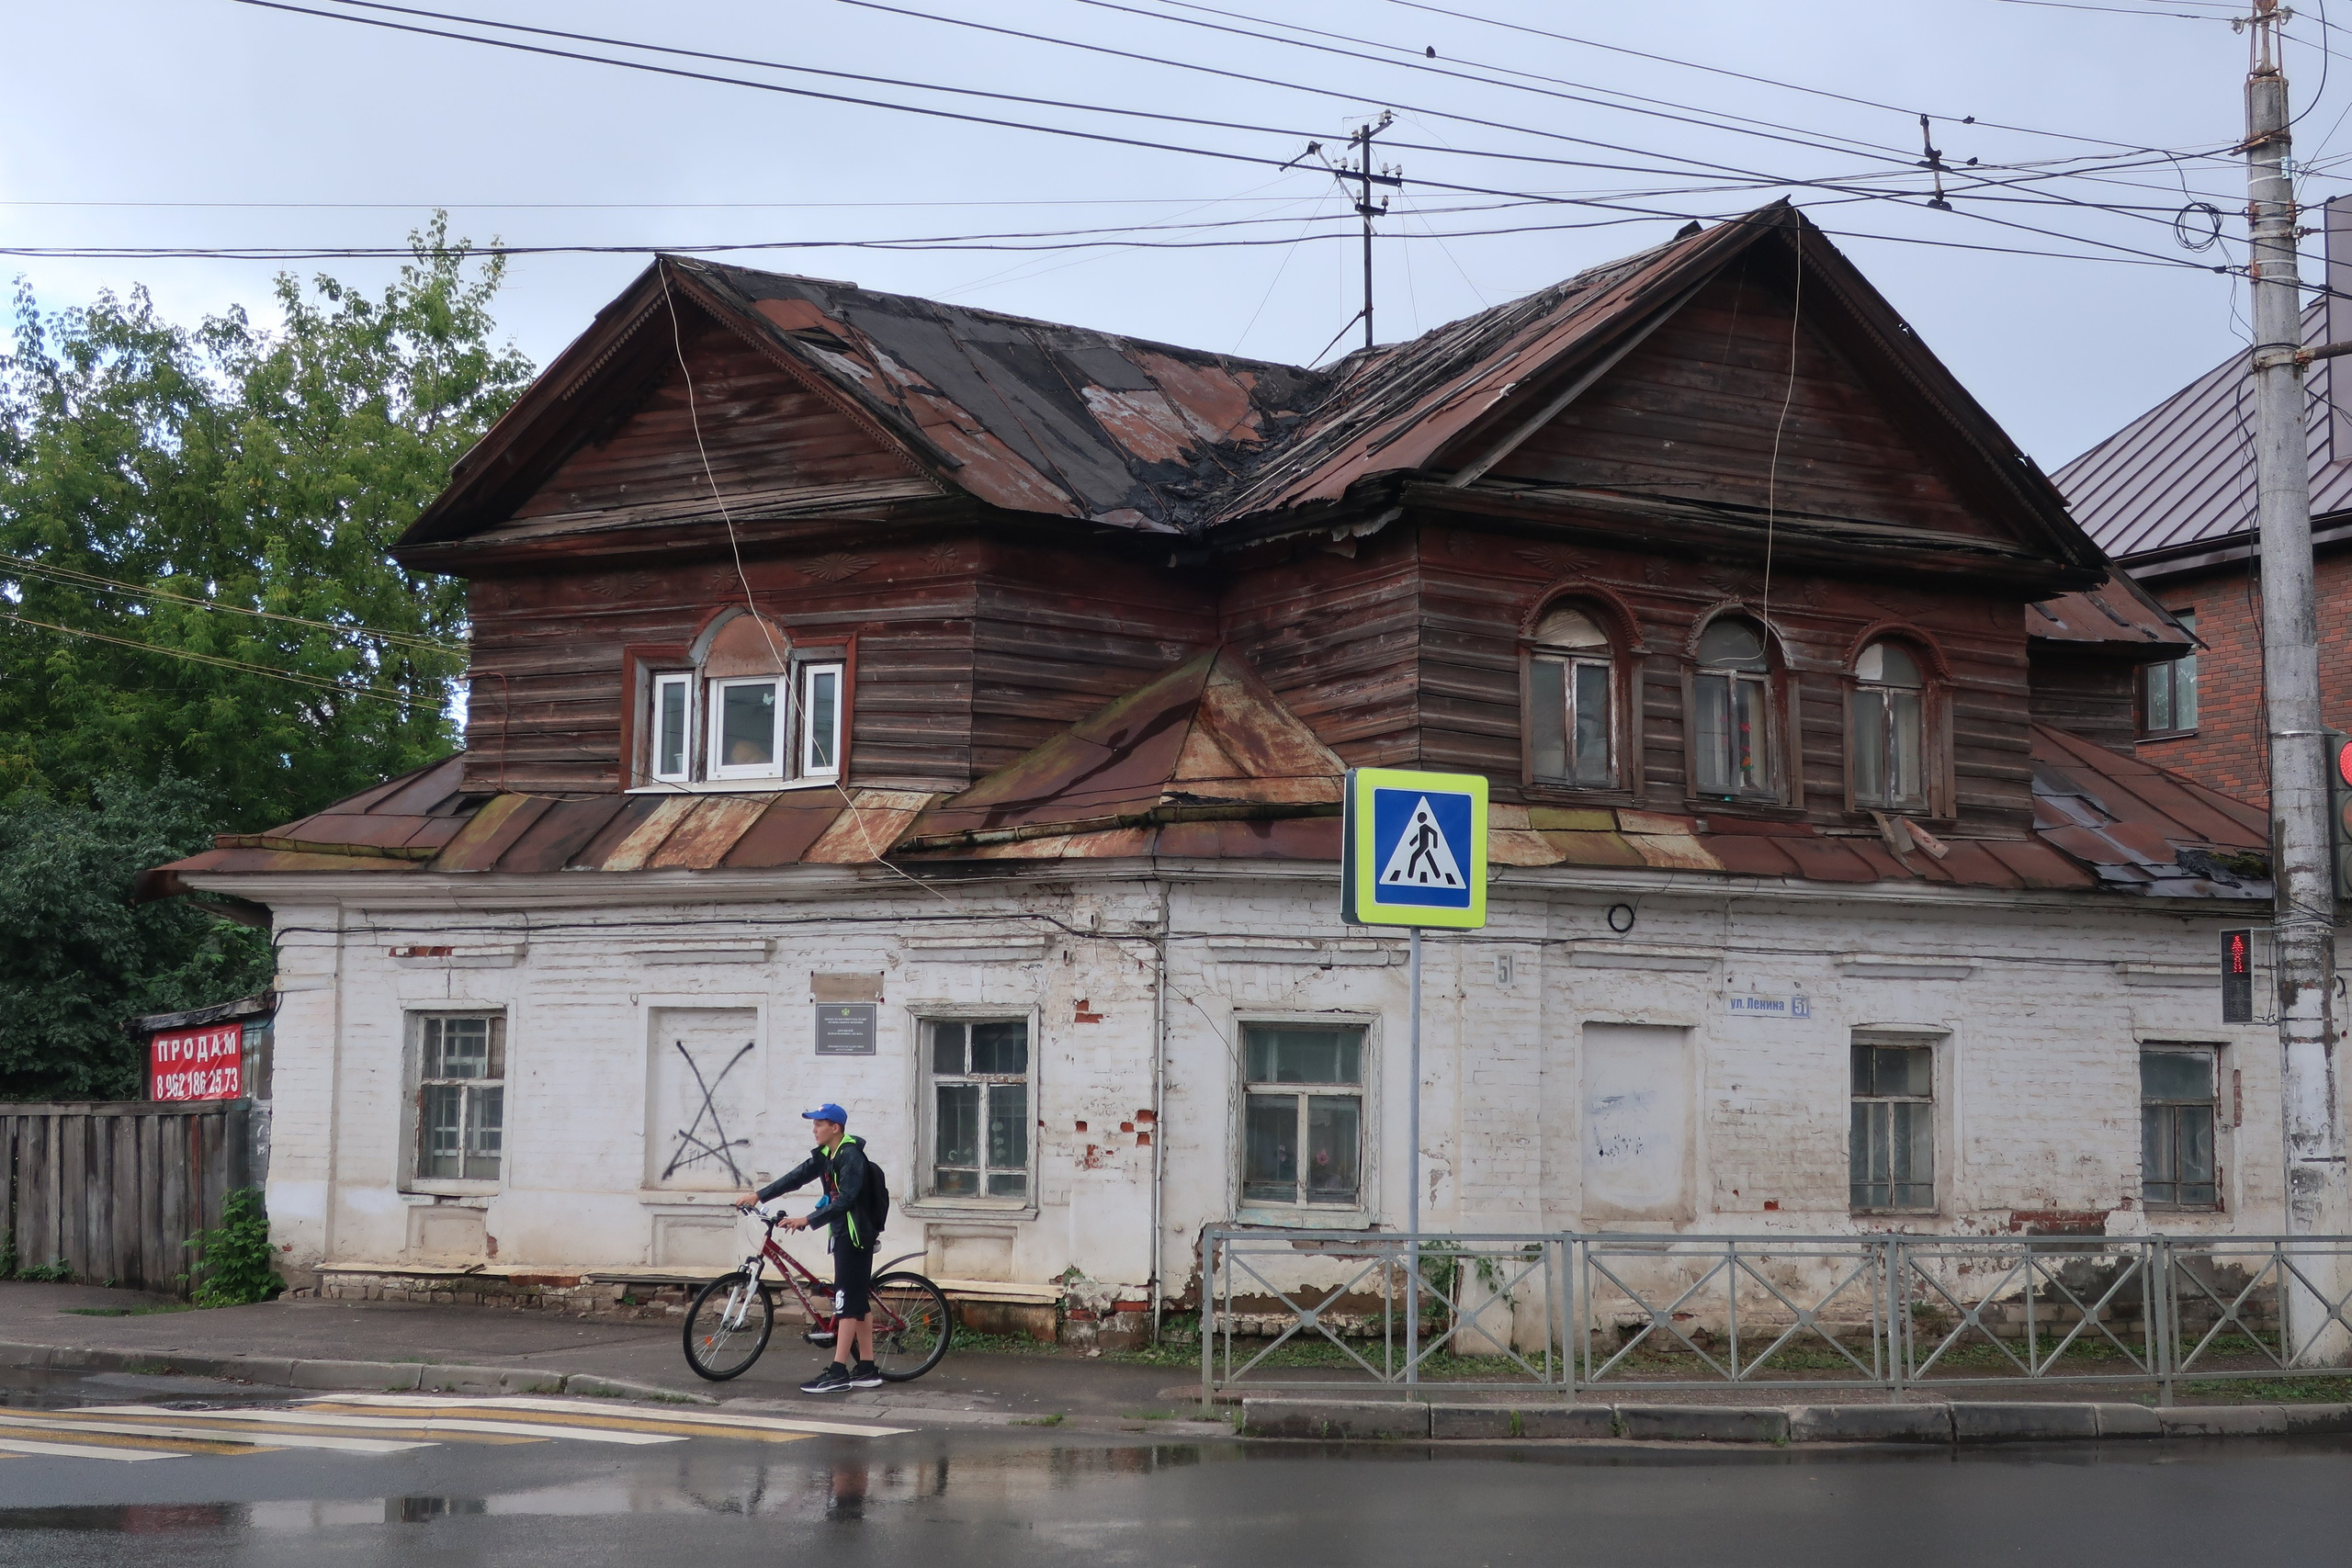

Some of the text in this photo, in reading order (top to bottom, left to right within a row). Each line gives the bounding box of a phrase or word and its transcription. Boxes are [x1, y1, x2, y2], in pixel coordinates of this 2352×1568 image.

[1498, 955, 1513, 983] 51
[1730, 997, 1807, 1014] ул. Ленина 51
[158, 1032, 236, 1063] ПРОДАМ
[157, 1066, 238, 1100] 8 962 186 25 73
